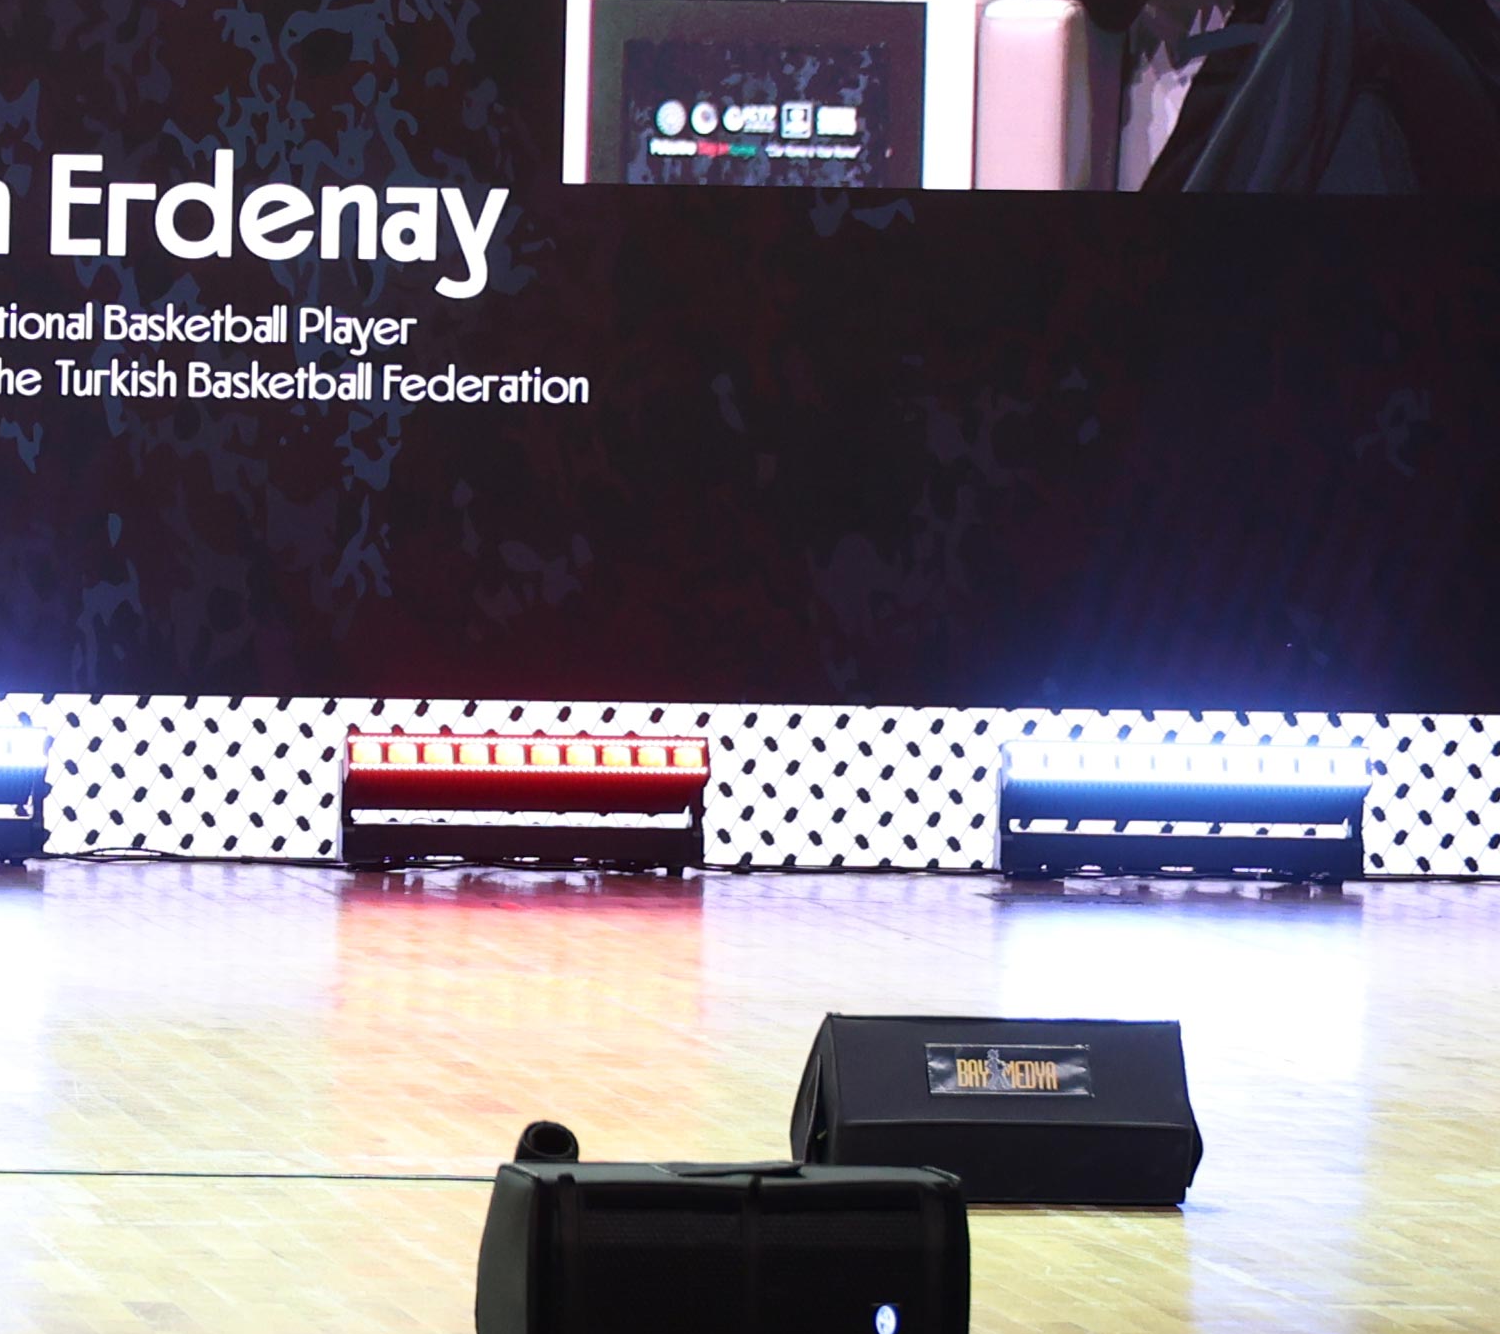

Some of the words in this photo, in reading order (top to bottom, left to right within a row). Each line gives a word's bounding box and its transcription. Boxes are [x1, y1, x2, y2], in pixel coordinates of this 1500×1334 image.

[51, 149, 510, 299] Erdenay
[104, 303, 288, 344] Basketball
[300, 306, 417, 355] Player
[55, 359, 177, 398] Turkish
[188, 361, 373, 401] Basketball
[384, 364, 589, 404] Federation
[956, 1059, 989, 1088] BAY
